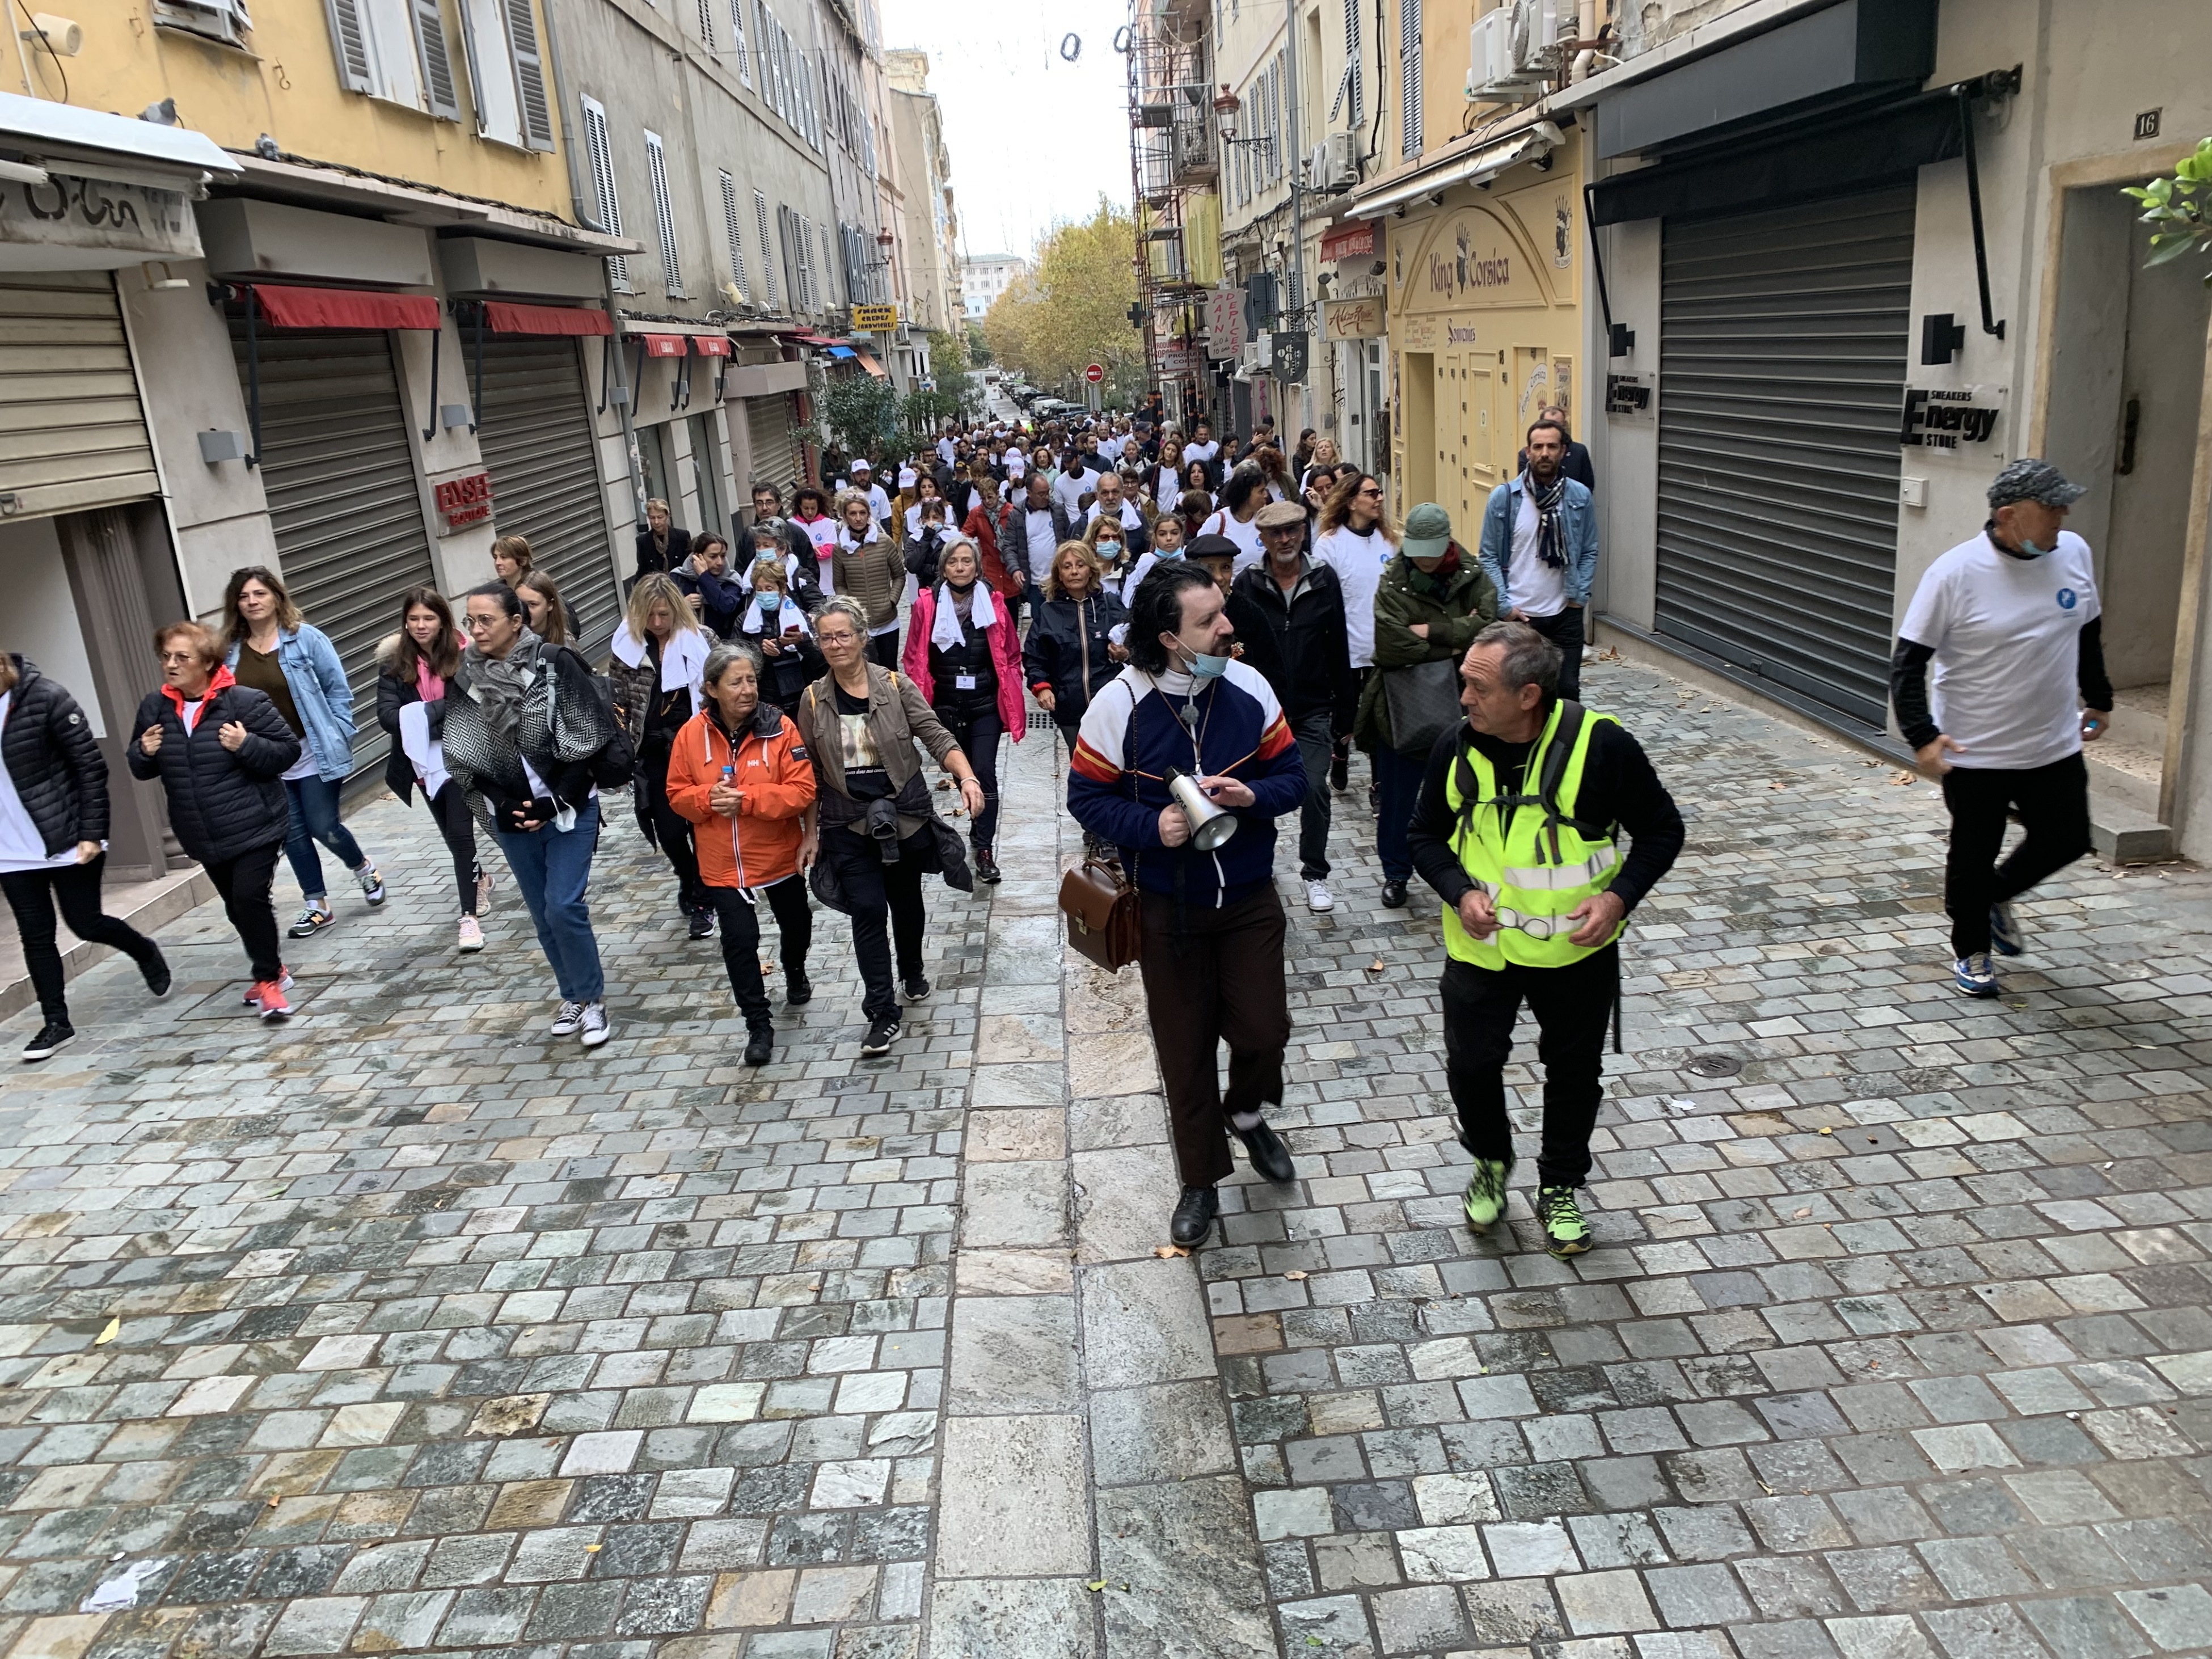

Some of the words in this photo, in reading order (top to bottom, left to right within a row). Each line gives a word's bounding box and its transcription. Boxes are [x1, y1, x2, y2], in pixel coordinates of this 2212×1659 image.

[2139, 114, 2155, 135] 16
[1430, 252, 1453, 301] King
[1470, 247, 1509, 288] Corsica
[1213, 294, 1224, 334] PAIN
[1447, 318, 1476, 348] Souvenirs
[1498, 349, 1504, 365] 18
[1605, 374, 1650, 412] Energy
[1931, 390, 1972, 402] SNEAKERS
[1900, 389, 1999, 445] Energy
[1926, 433, 1957, 449] STORE
[1175, 793, 1187, 812] PYLE
